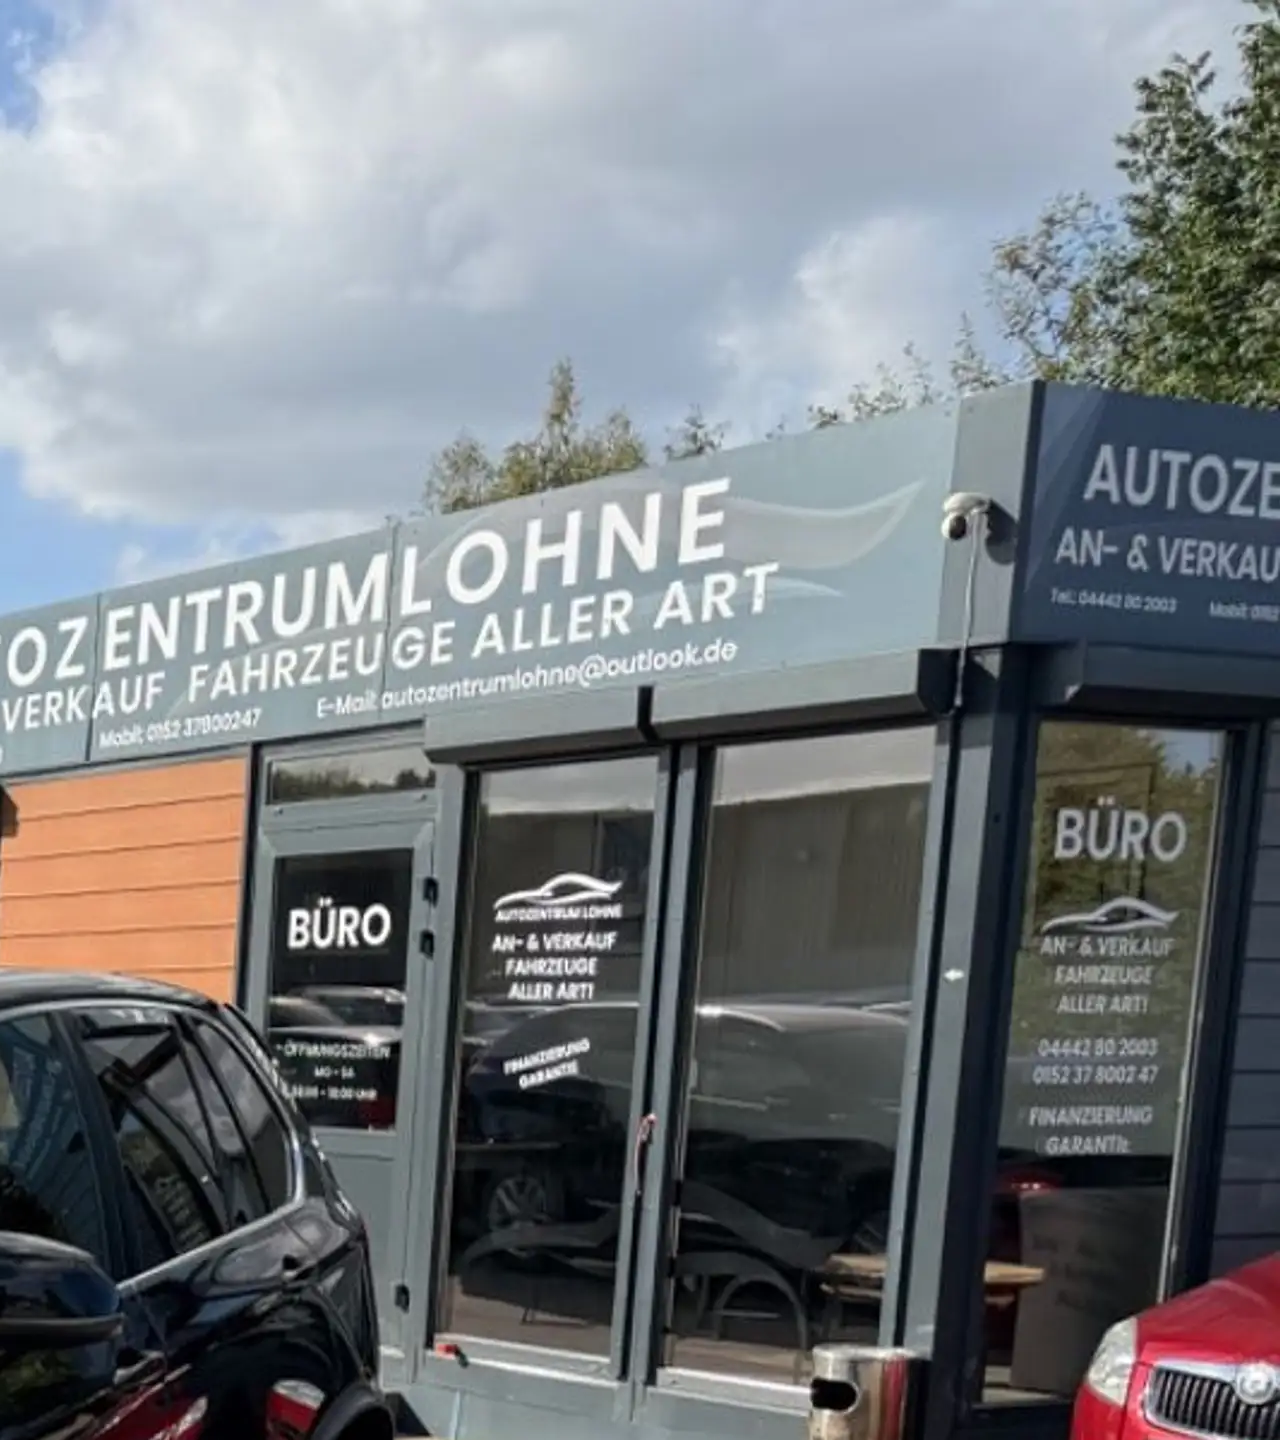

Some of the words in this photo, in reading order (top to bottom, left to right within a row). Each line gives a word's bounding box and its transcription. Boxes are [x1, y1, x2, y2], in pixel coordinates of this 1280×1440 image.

[1084, 444, 1280, 520] AUTOZE
[1055, 527, 1118, 567] AN-
[1127, 534, 1149, 571] &
[1, 669, 164, 733] VERKAUF
[187, 620, 457, 703] FAHRZEUGE
[471, 589, 632, 657] ALLER
[653, 562, 779, 629] ART
[1054, 796, 1187, 862] BÜRO
[287, 897, 391, 949] BÜRO
[492, 932, 524, 952] AN-
[542, 930, 618, 952] VERKAUF
[1078, 934, 1093, 958] &
[1097, 934, 1176, 957] VERKAUF
[505, 956, 598, 976] FAHRZEUGE
[1054, 964, 1154, 985] FAHRZEUGE
[507, 981, 553, 1000] ALLER
[1056, 994, 1106, 1016] ALLER
[1028, 1106, 1154, 1127] FINANZIERUNG
